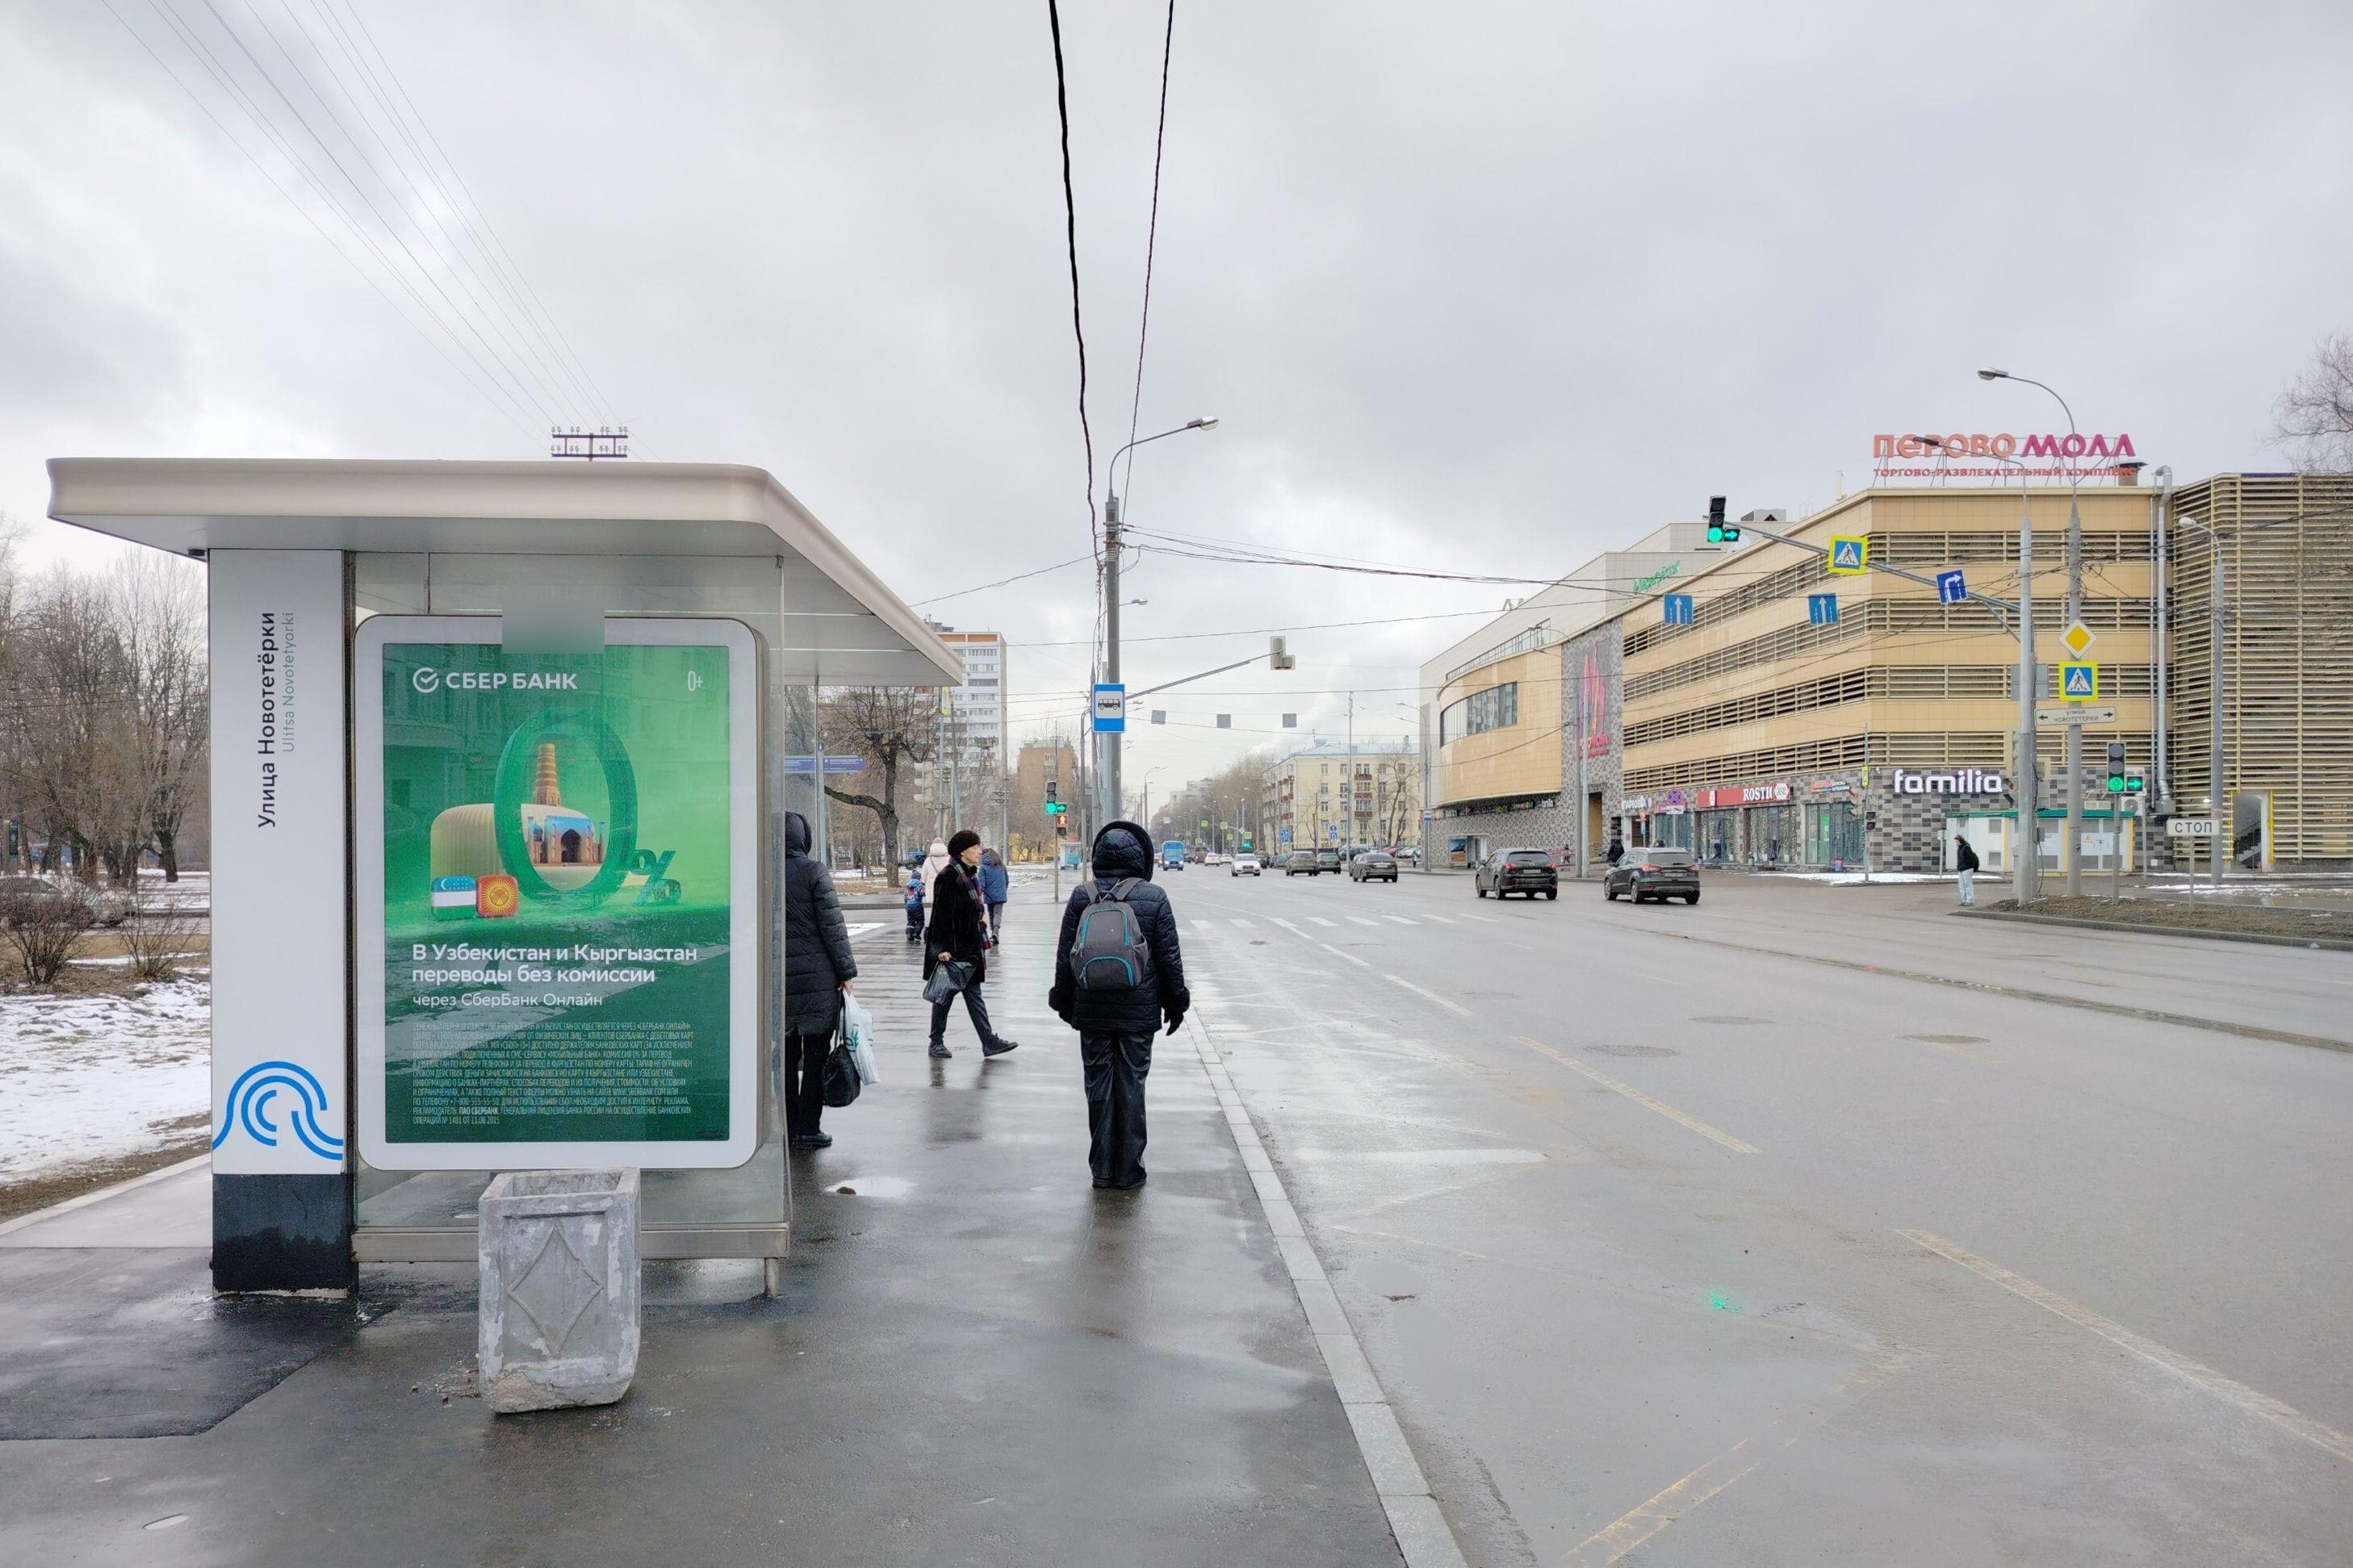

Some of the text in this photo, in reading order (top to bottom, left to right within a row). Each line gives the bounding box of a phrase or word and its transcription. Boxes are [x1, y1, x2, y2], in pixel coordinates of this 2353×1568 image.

[2020, 433, 2135, 458] МОЛЛ
[1874, 467, 2066, 478] ТОРГОВО-РАЗВЛЕКАТЕЛЬНЫЙ
[282, 613, 296, 752] Ulitsa Novotetyorki
[446, 672, 578, 690] СБЕР БАНК
[688, 671, 703, 692] 0+
[257, 613, 278, 828] Улица Новотетёрки
[1895, 769, 2002, 793] familia
[2175, 822, 2212, 833] СТОП
[412, 943, 697, 965] В Узбекистан и Кыргызстан
[412, 965, 656, 985] переводы без комиссии
[412, 993, 603, 1009] через СберБанк Онлайн
